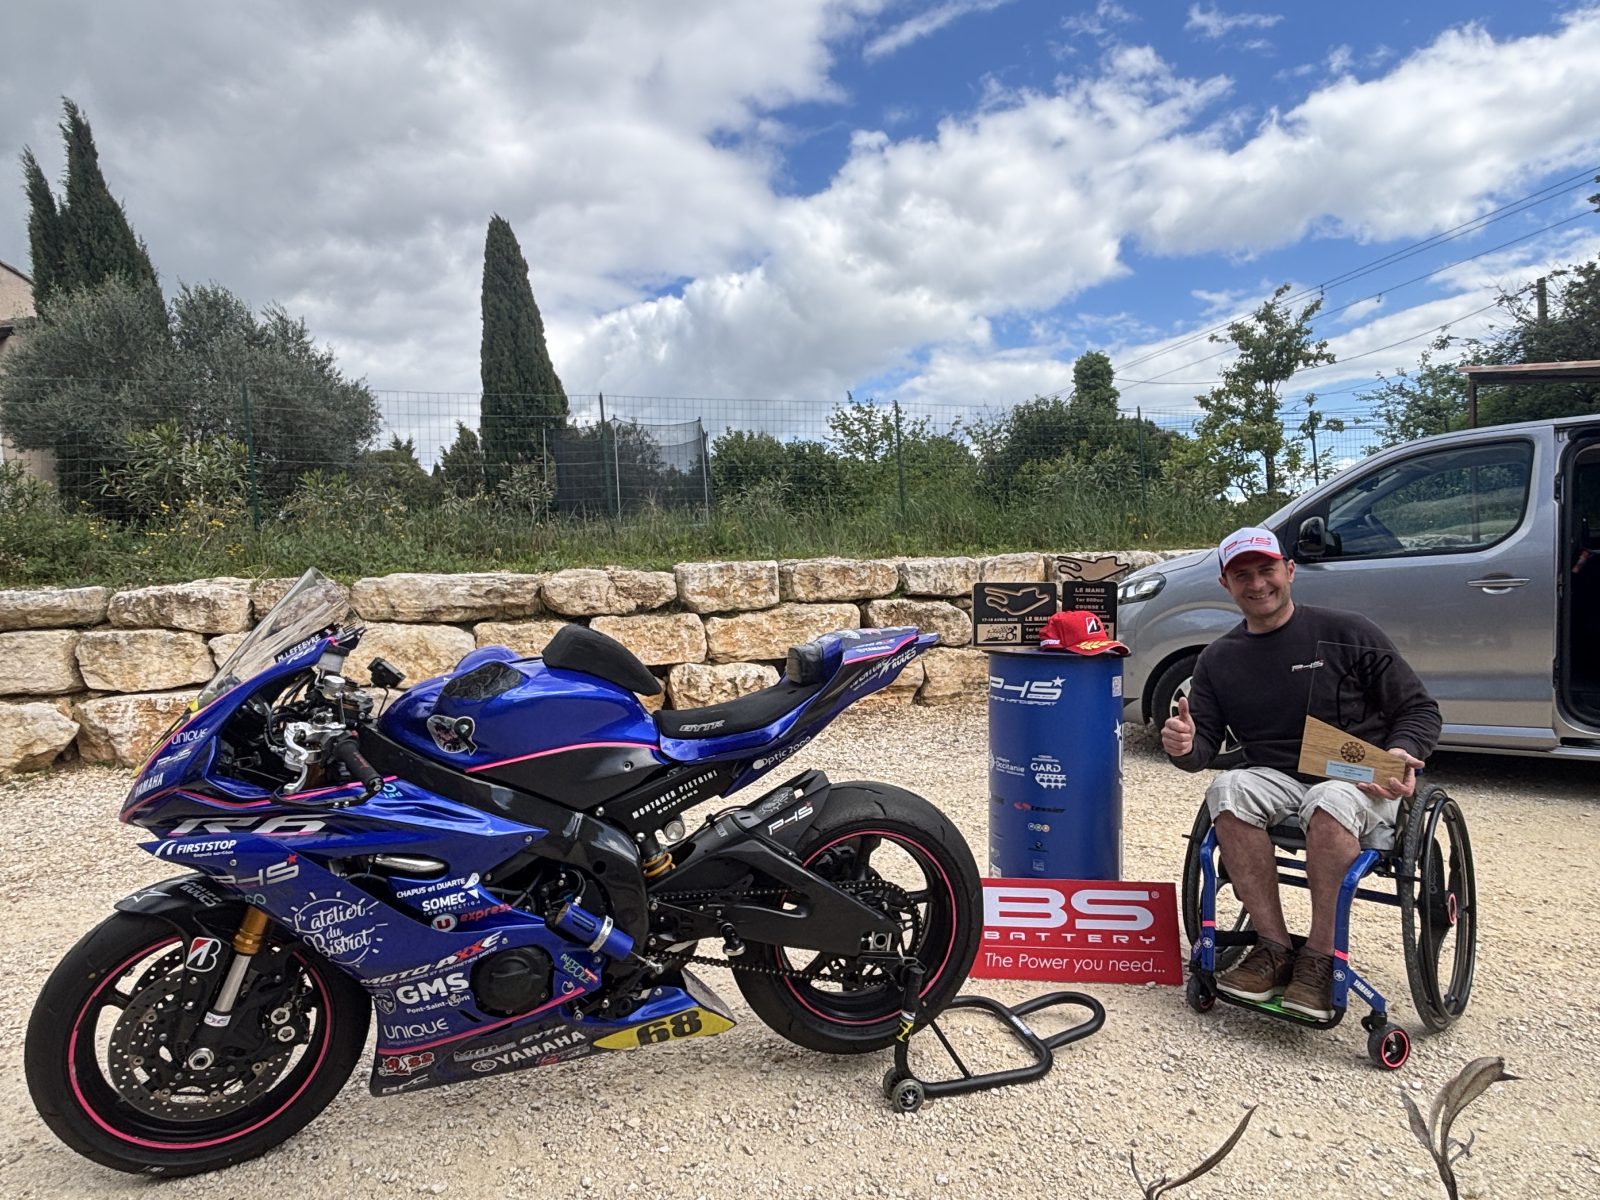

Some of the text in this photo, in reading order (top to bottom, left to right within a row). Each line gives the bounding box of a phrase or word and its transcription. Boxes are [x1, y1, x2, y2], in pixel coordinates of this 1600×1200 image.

[171, 728, 208, 745] UNIQUE
[788, 736, 811, 754] 2000
[1030, 762, 1061, 773] GARD
[632, 770, 718, 819] MONTANER PIETRINI
[176, 839, 238, 855] FIRSTSTOP
[396, 877, 466, 899] CHAPUS et DUARTE
[421, 892, 467, 912] SOMEC
[460, 903, 512, 922] express
[982, 886, 1154, 931] BS
[303, 926, 375, 957] Bistrot
[326, 926, 342, 940] du
[983, 930, 1156, 944] BATTERY
[985, 952, 1013, 968] The
[1018, 953, 1069, 970] Power
[1074, 959, 1102, 974] you
[396, 972, 469, 1005] GMS
[1353, 978, 1374, 1000] YAMAHA
[384, 1018, 449, 1040] UNIQUE
[636, 1010, 702, 1046] 68
[495, 1031, 586, 1065] YAMAHA
